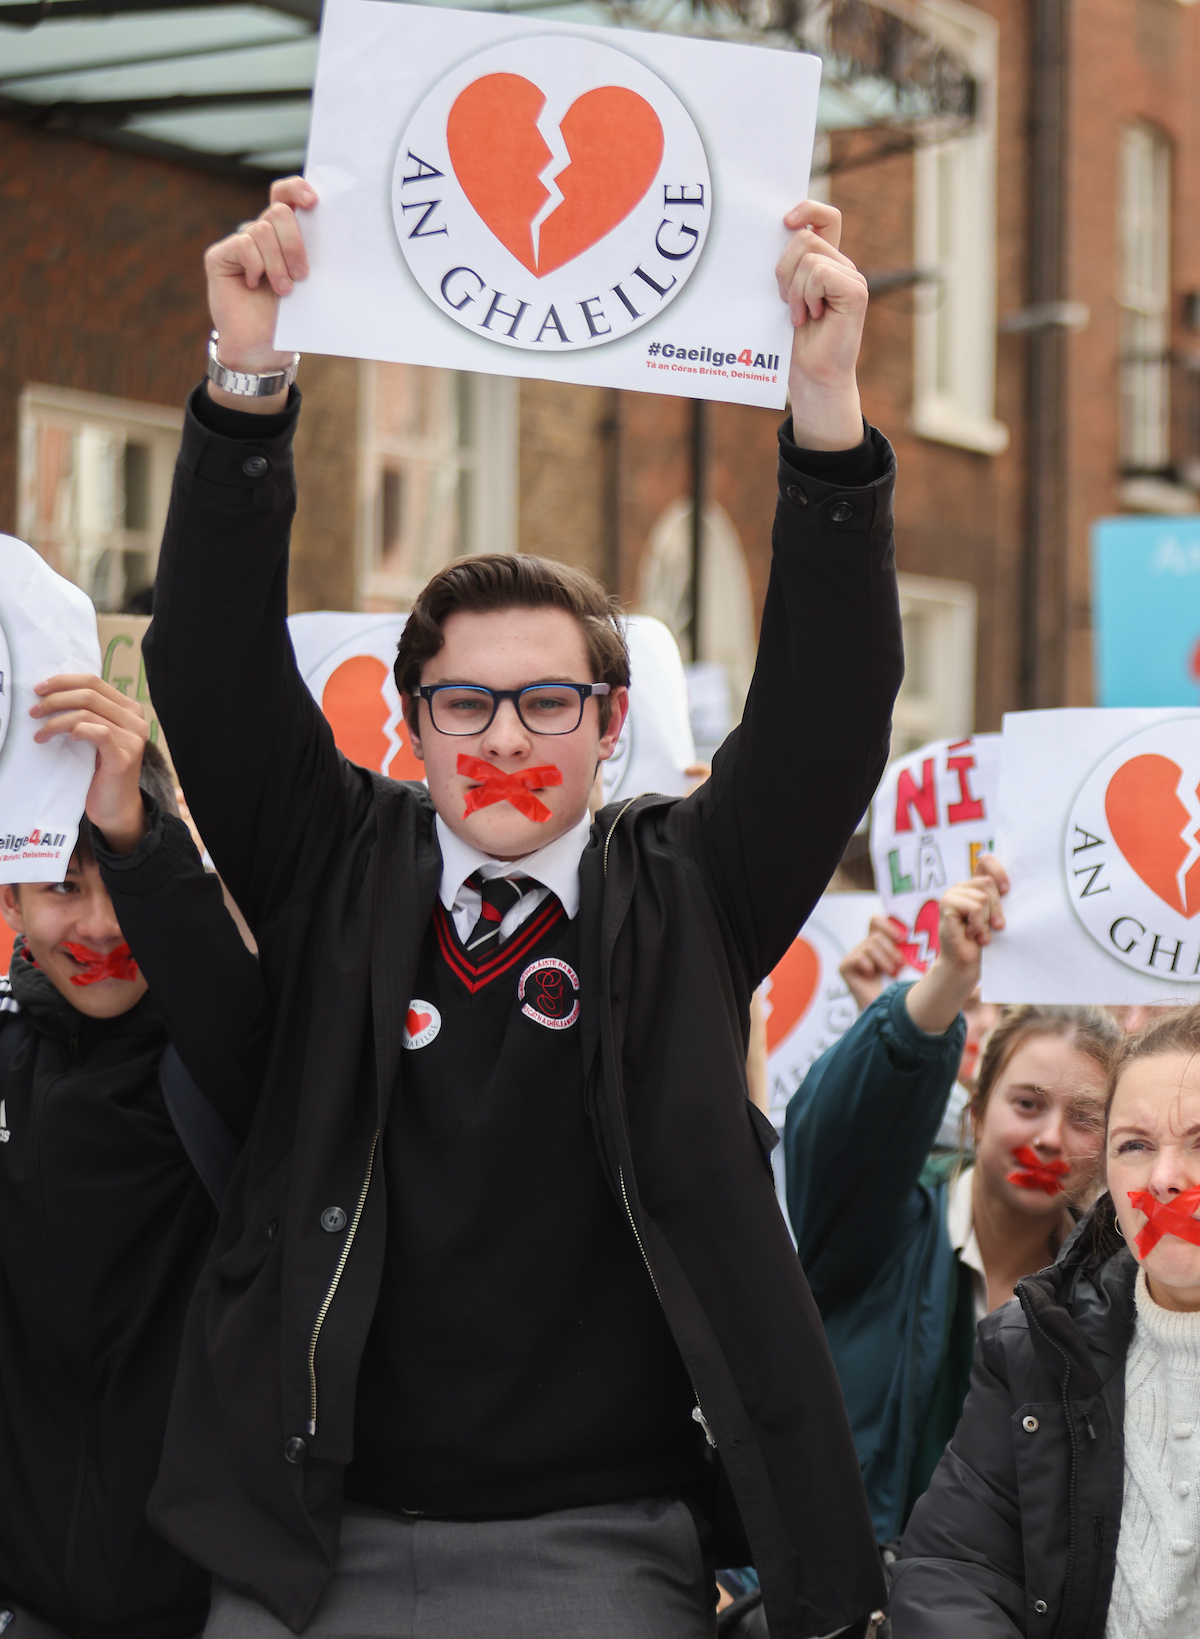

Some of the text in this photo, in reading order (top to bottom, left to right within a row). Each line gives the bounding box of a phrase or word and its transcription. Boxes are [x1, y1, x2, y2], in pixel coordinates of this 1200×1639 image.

[402, 148, 705, 344] AN GHAEILGE
[648, 342, 780, 370] #Gaeilge4All
[646, 360, 778, 384] Tá an Córas Briste, Deisímis É
[895, 739, 985, 834] NÍ
[0, 829, 67, 852] eilge4All
[1072, 823, 1112, 899] AN
[404, 1024, 438, 1048] HAEILGE
